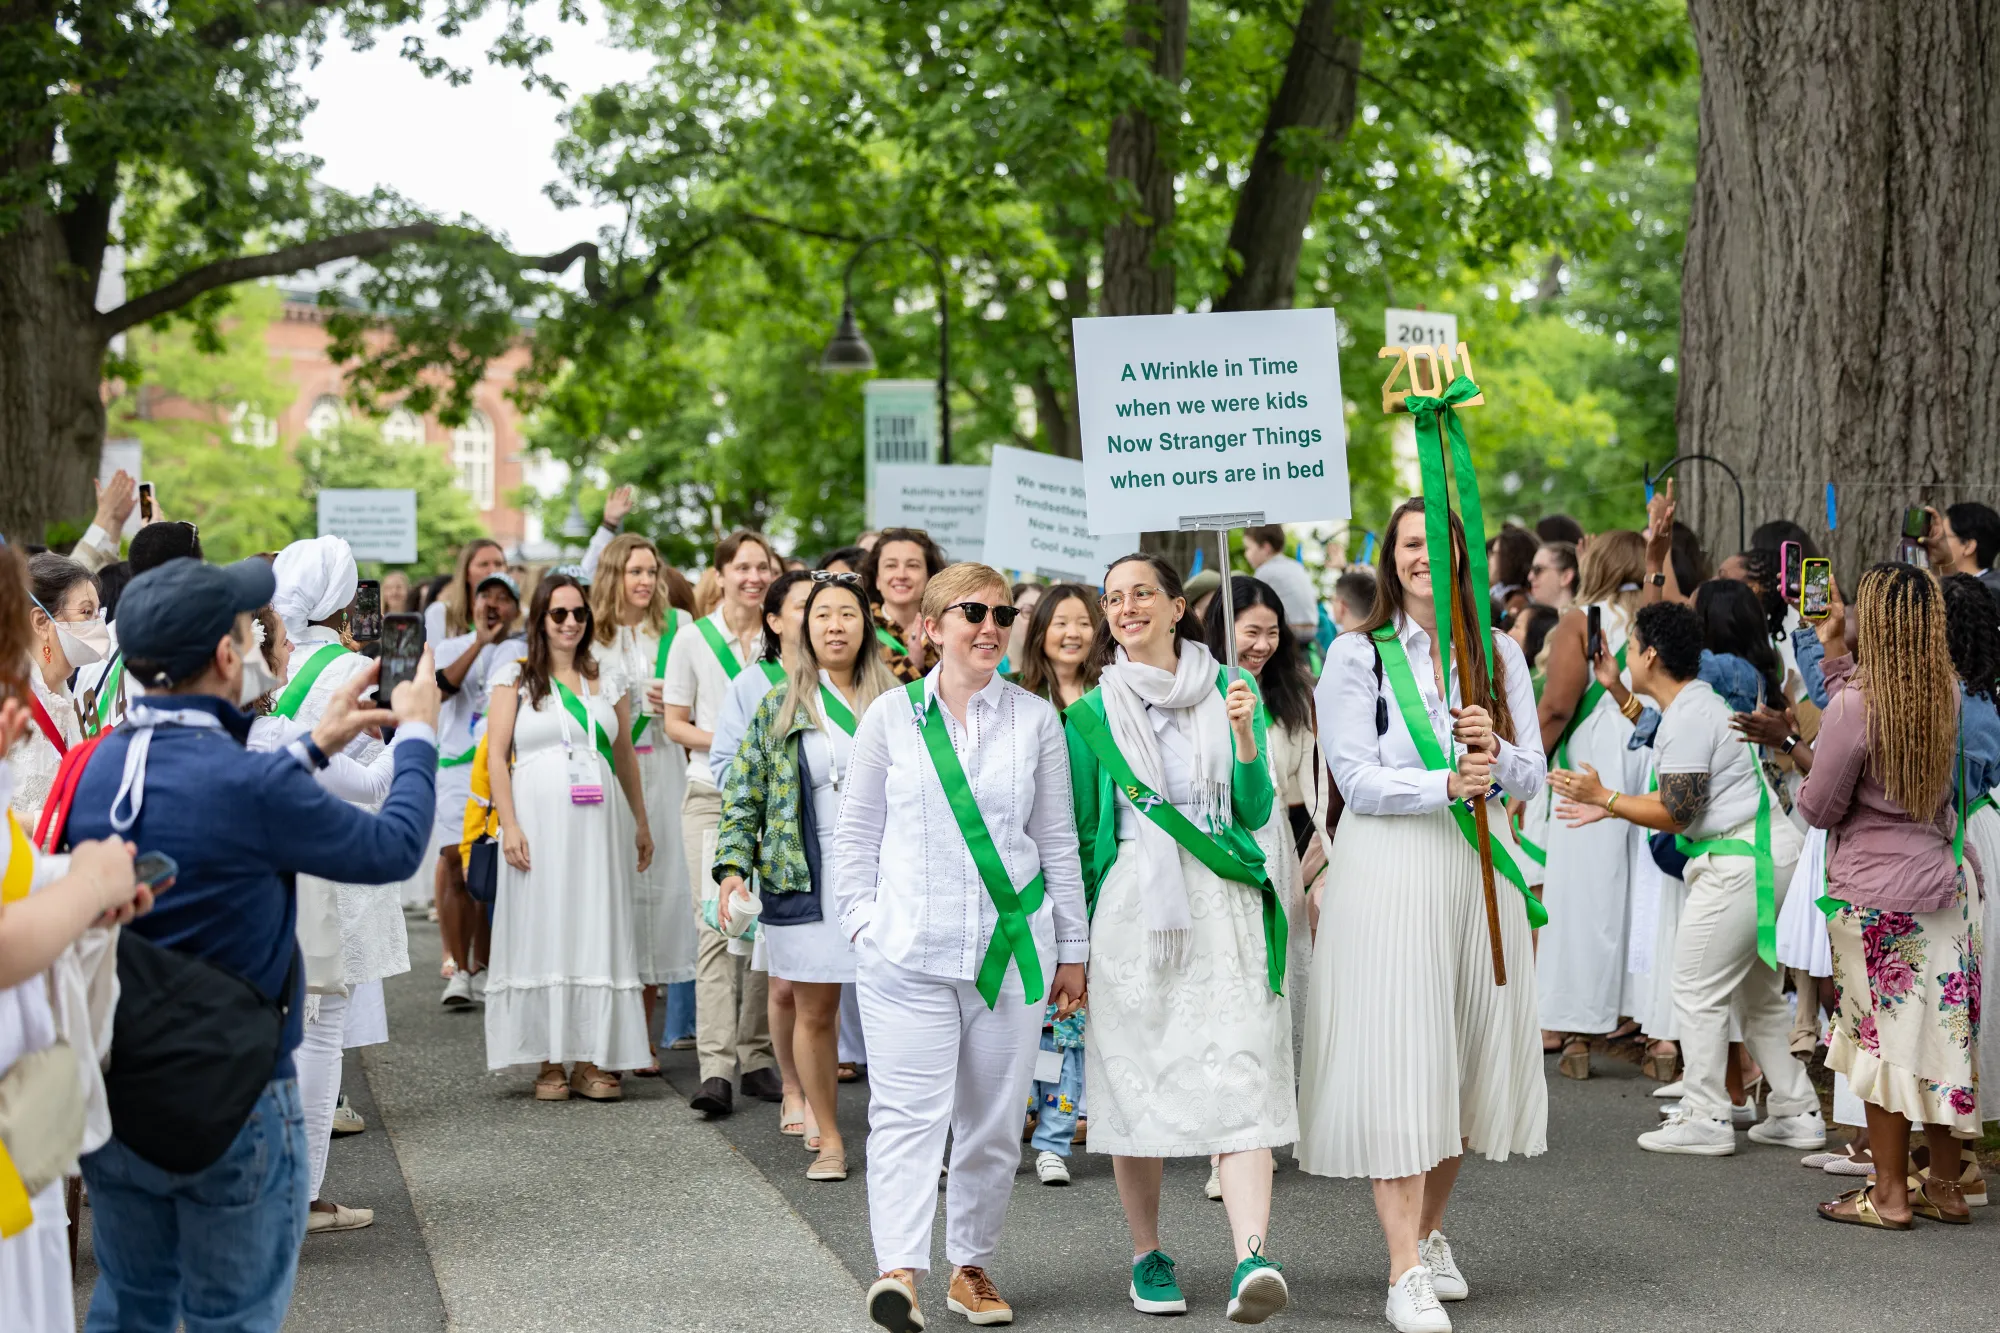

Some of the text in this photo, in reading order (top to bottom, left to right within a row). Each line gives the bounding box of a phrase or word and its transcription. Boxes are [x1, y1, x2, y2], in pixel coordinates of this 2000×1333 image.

[1398, 324, 1445, 344] 2011
[1121, 357, 1298, 382] A Wrinkle in Time
[1378, 342, 1480, 399] 2011
[1115, 391, 1308, 418] when we were kids
[1107, 426, 1322, 454] Now Stranger Things
[1016, 475, 1035, 488] We
[1038, 482, 1067, 495] were
[1110, 459, 1324, 489] when ours are in bed
[1014, 494, 1088, 519] Trendsetters
[1028, 517, 1055, 531] Now
[1058, 523, 1069, 534] in
[1030, 537, 1095, 560] Cool again
